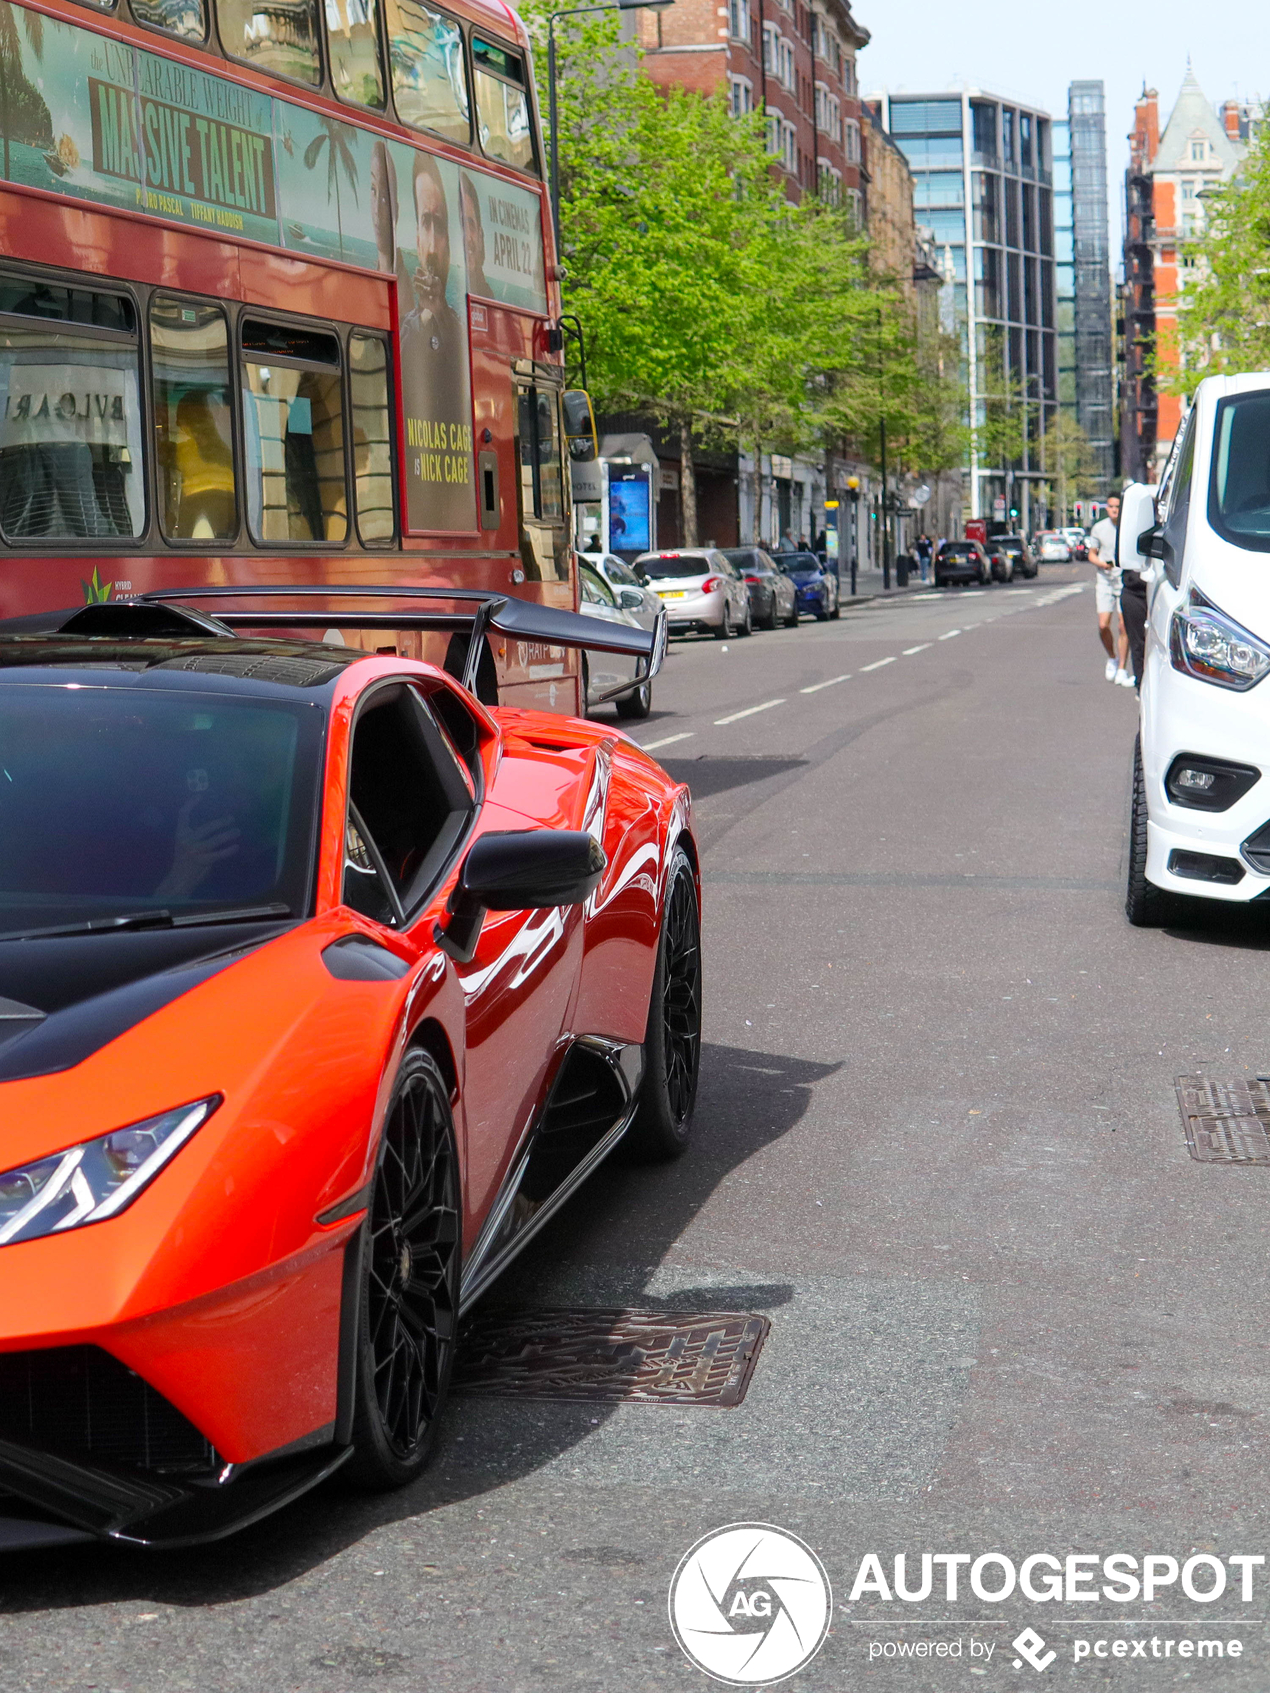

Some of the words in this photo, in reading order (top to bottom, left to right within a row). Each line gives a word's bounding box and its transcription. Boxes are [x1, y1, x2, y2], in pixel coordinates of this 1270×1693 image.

[91, 48, 103, 72] the
[202, 77, 252, 128] WEIGHT
[98, 84, 195, 194] MASSIVE
[195, 118, 266, 214] TALENT
[158, 194, 184, 217] PASCAL
[190, 202, 216, 224] TIFFANY
[488, 195, 498, 224] IN
[498, 199, 530, 235] CINEMAS
[494, 231, 521, 272] APRIL
[521, 241, 532, 276] 22
[407, 418, 447, 450] NICOLAS
[450, 423, 472, 452] CAGE
[420, 453, 442, 482] NICK
[444, 455, 468, 484] CAGE
[114, 580, 132, 591] HYBRID
